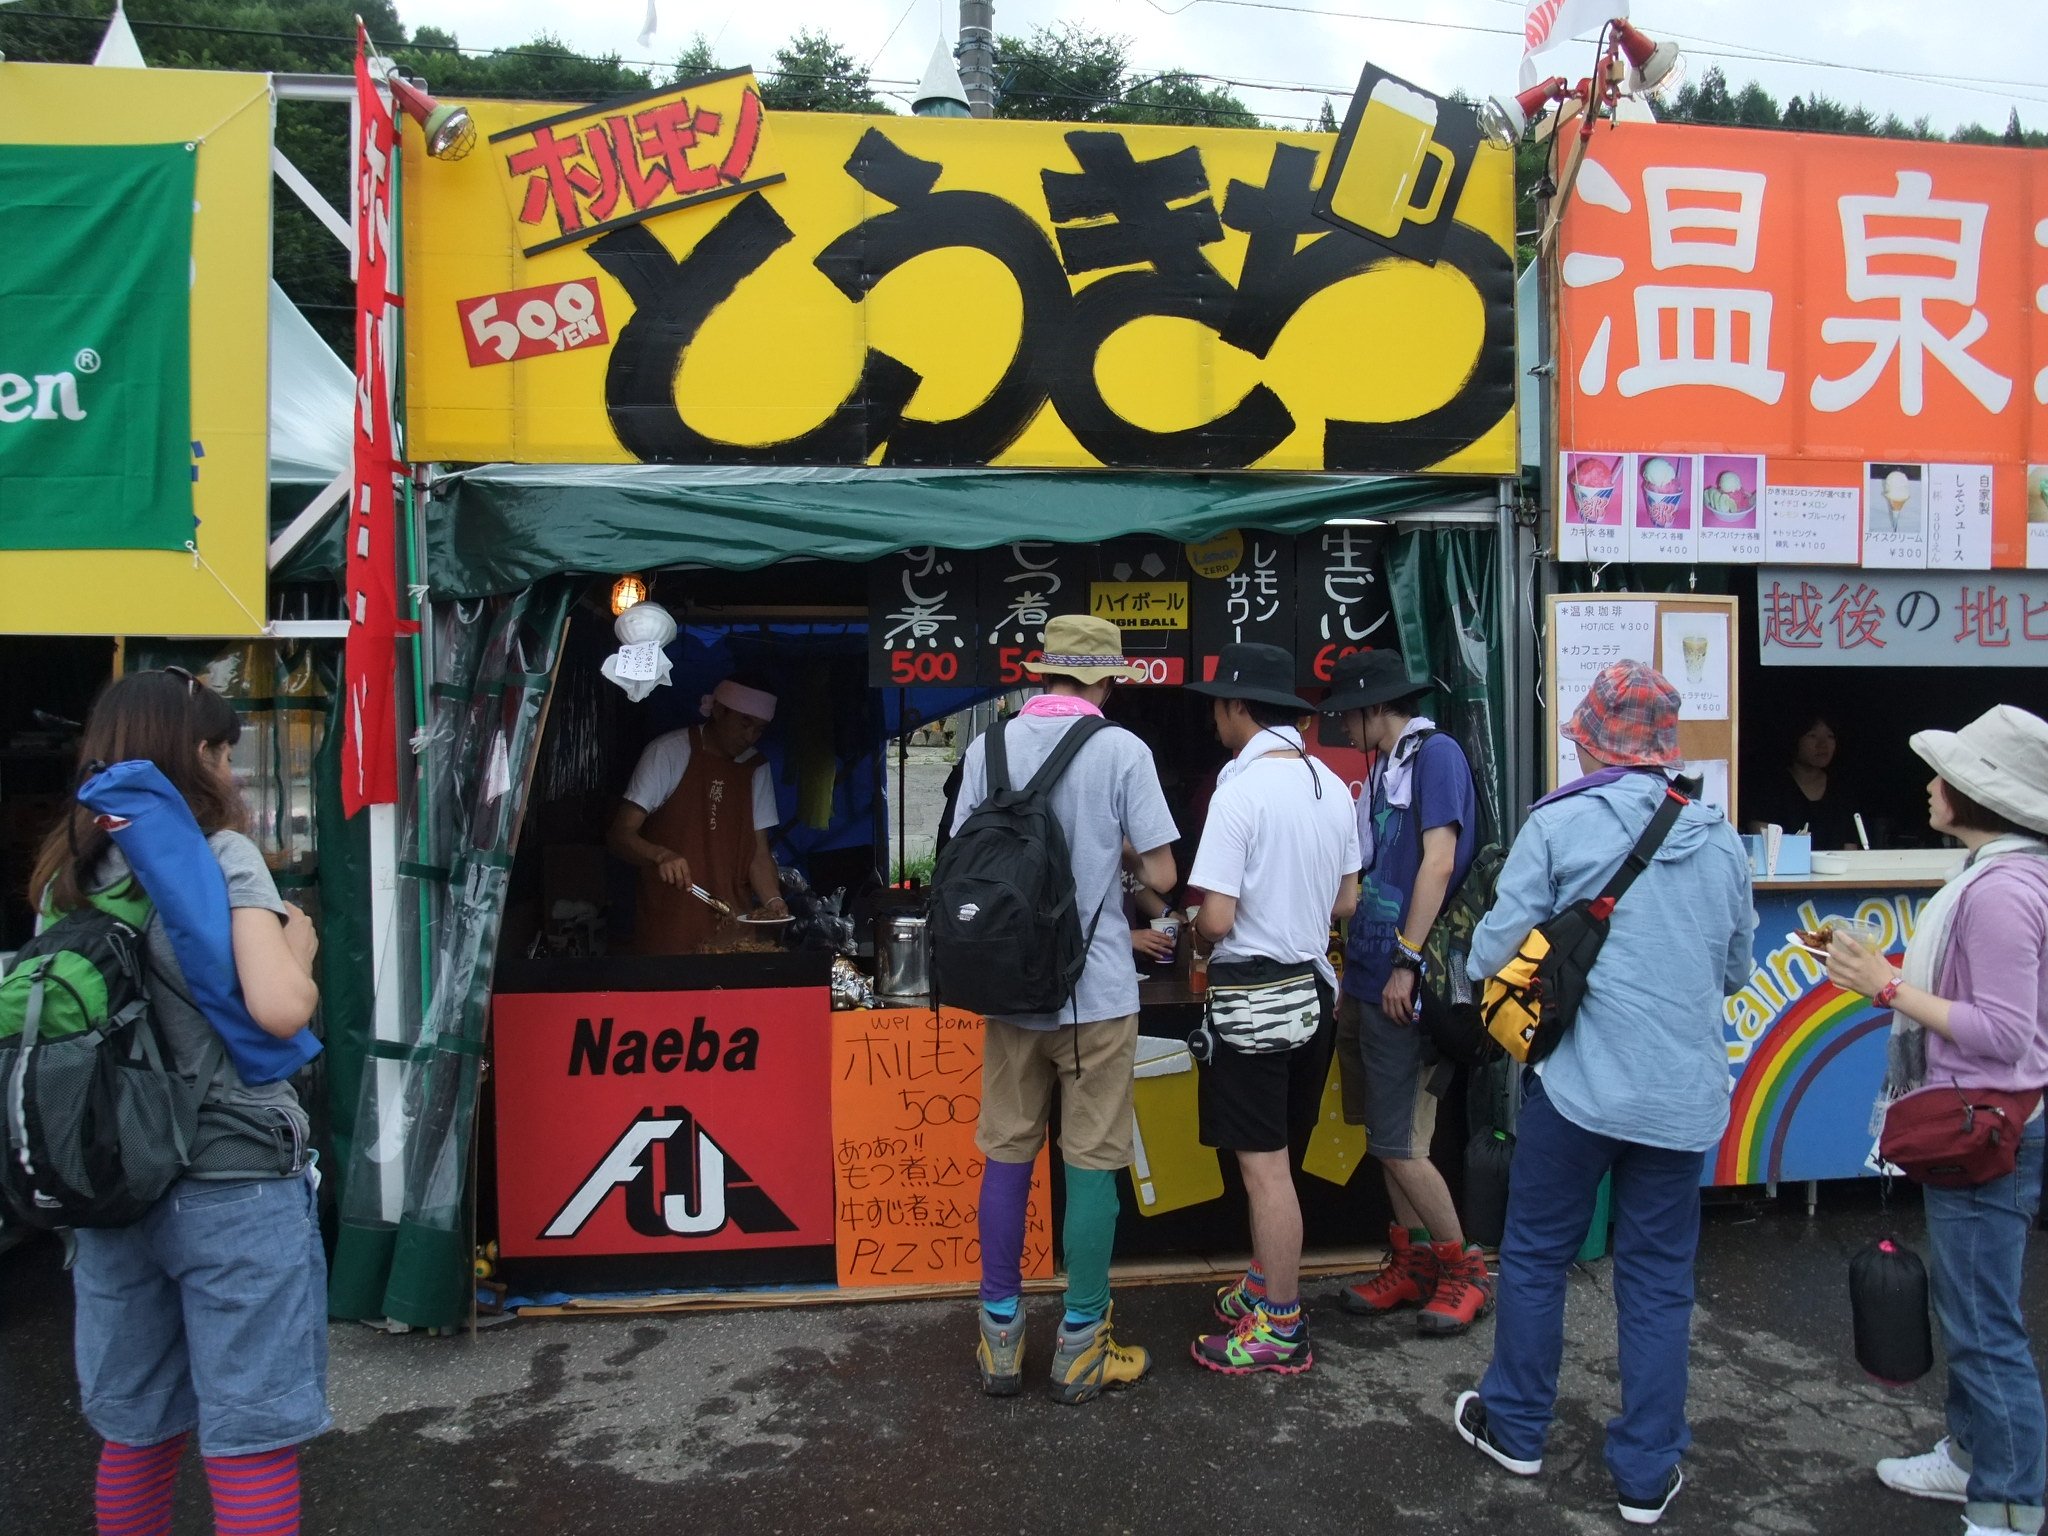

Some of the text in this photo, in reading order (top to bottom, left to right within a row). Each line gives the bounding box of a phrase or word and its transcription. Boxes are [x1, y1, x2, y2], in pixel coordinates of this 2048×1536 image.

[506, 84, 763, 236] ホルモン
[1563, 159, 2048, 417] 温泉
[469, 283, 601, 361] 500 YEN
[1978, 475, 1990, 515] 自家製
[1864, 533, 1923, 543] アイスクリーム
[1953, 474, 1966, 562] しそジュース
[1203, 564, 1230, 575] ZERO
[1889, 548, 1922, 558] ¥300
[1095, 592, 1185, 612] ハイボール
[1140, 618, 1178, 627] BALL
[1580, 622, 1649, 631] HOT/ICE ¥300
[891, 650, 958, 684] 500
[1570, 645, 1621, 656] カフェラテ
[567, 1017, 760, 1077] Naeba
[844, 1032, 983, 1086] ホルモン
[895, 1089, 981, 1131] 500
[850, 1238, 918, 1276] PLZ
[928, 1236, 982, 1270] STO
